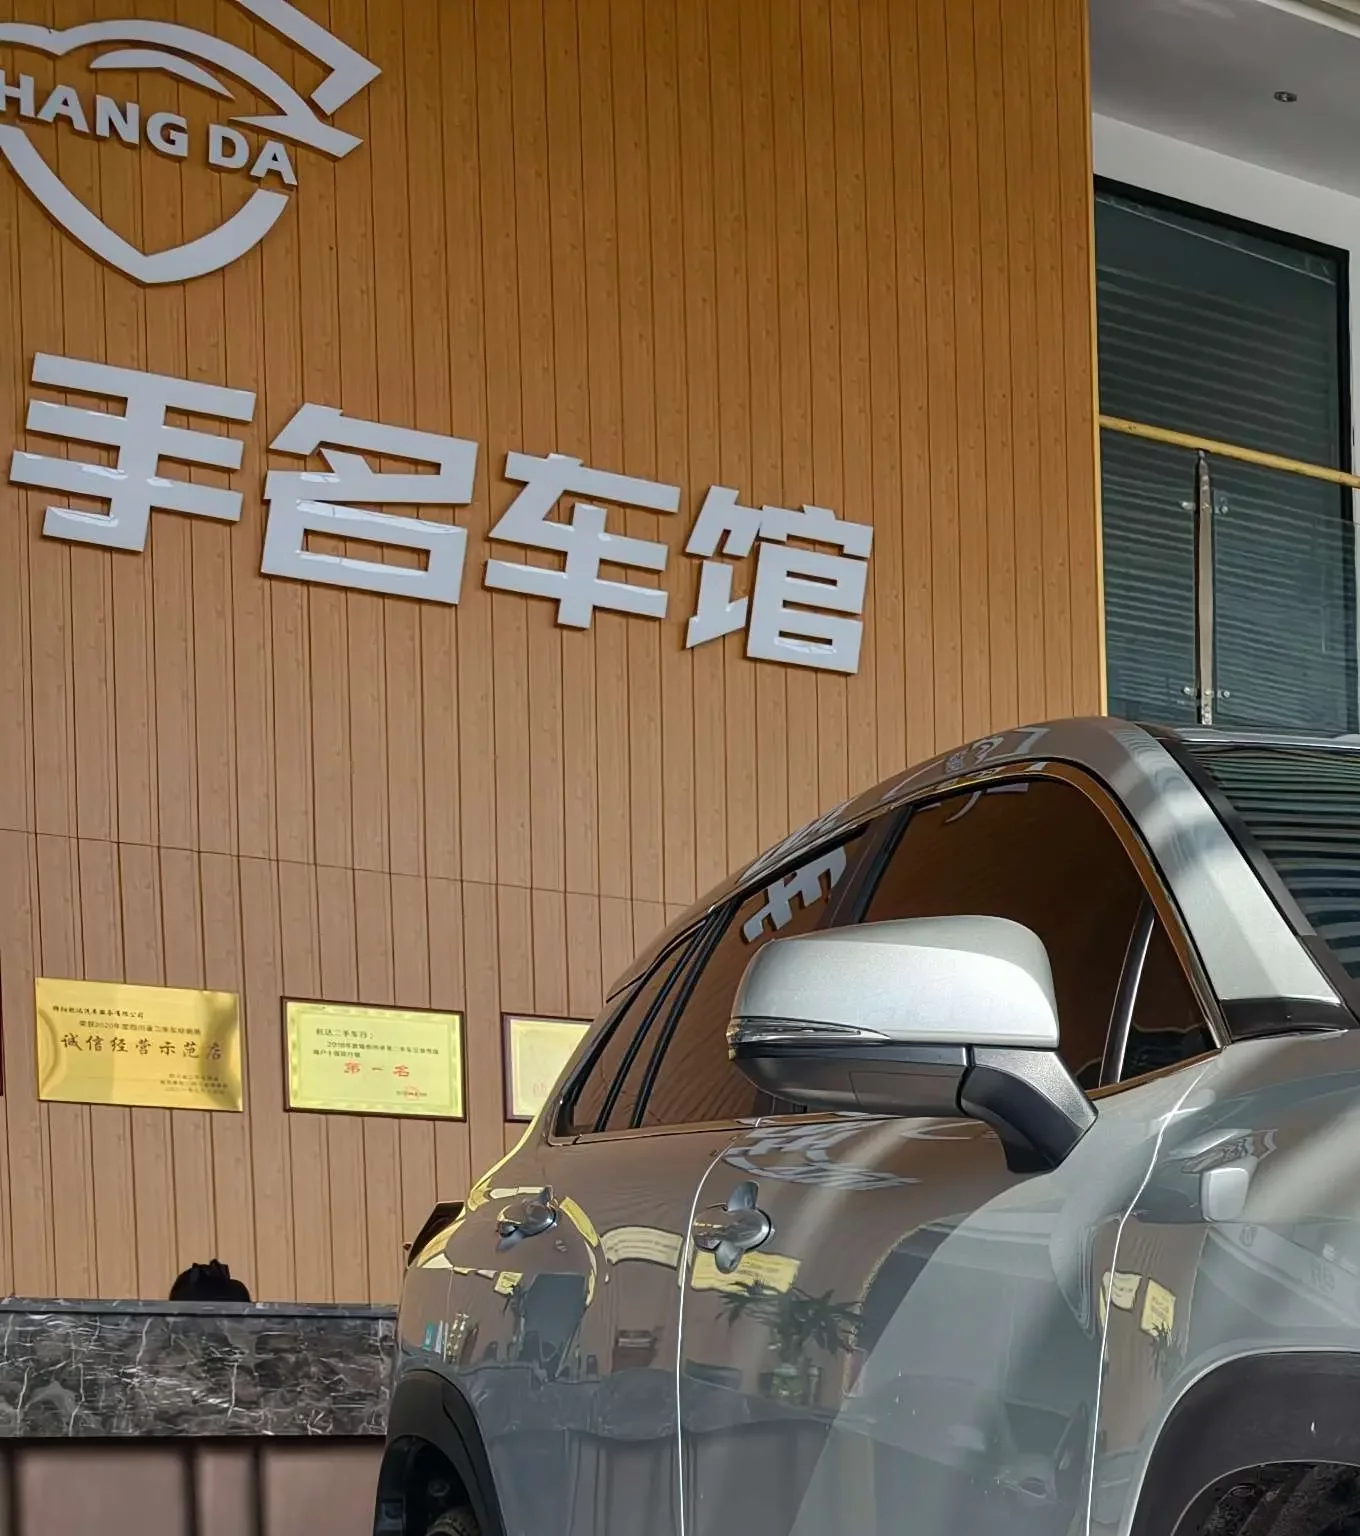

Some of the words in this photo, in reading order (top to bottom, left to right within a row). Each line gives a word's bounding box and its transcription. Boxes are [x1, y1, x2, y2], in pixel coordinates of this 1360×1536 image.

[0, 69, 188, 157] HANG
[208, 122, 298, 187] DA
[10, 351, 874, 675] 手名车馆
